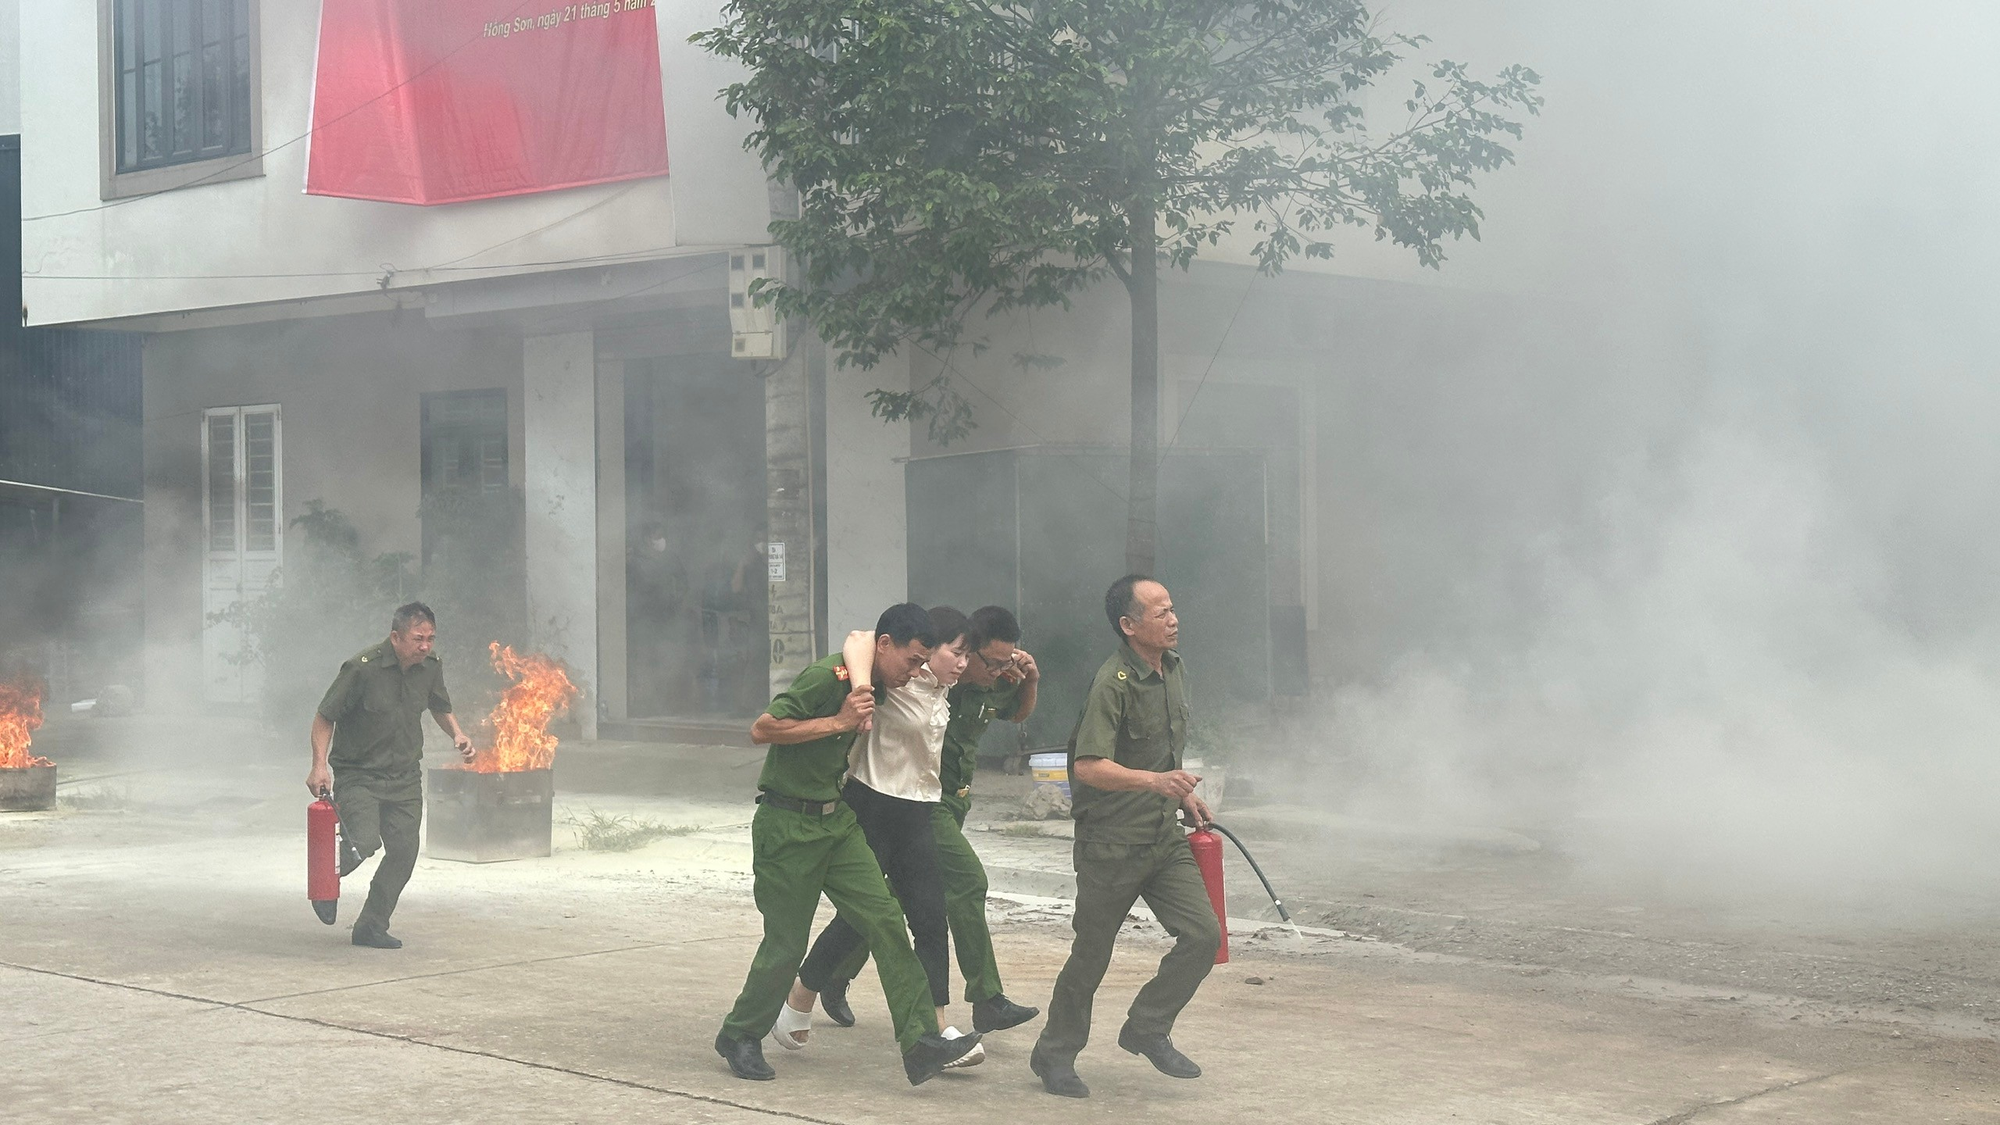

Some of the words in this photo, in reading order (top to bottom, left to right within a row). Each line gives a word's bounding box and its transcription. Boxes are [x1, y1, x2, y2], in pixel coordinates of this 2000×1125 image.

[537, 9, 562, 30] ngày
[563, 5, 577, 22] 21
[580, 1, 611, 19] tháng
[613, 0, 621, 13] 5
